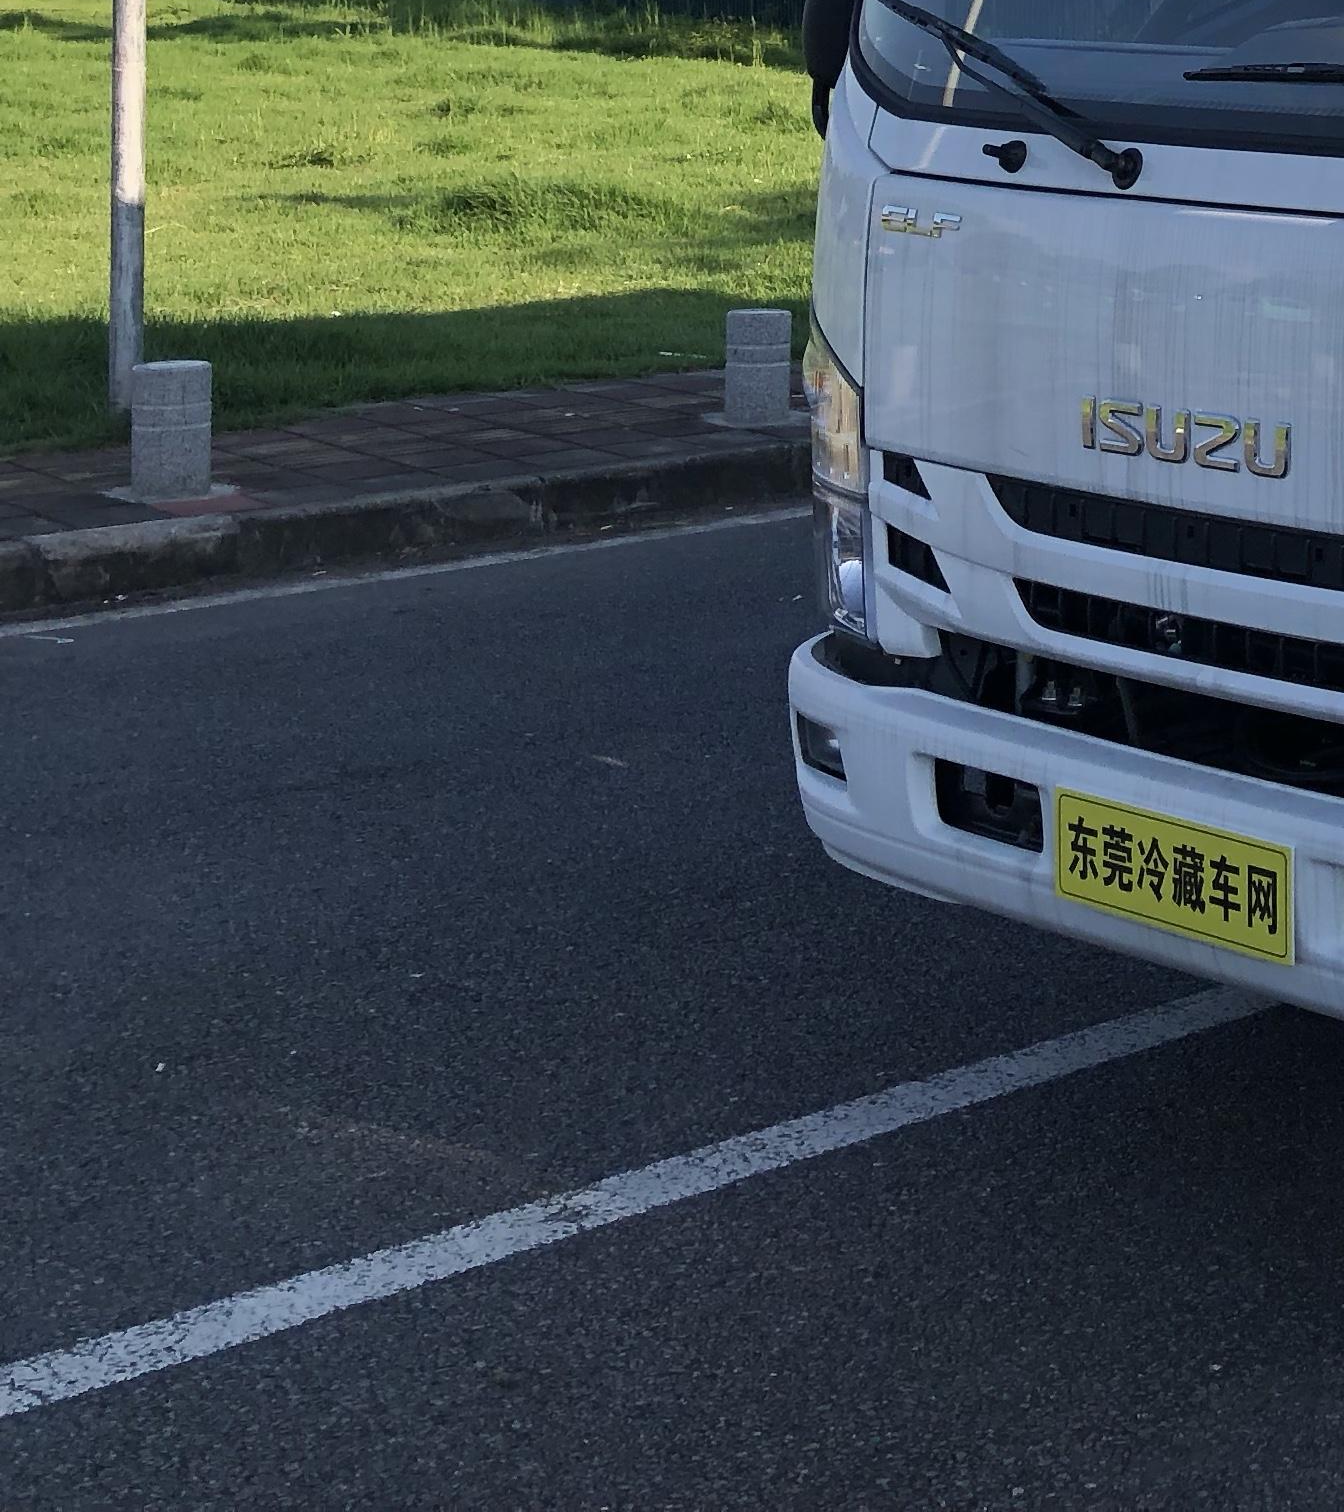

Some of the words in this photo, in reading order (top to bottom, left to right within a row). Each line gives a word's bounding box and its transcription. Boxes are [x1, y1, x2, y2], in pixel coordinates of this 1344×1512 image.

[881, 204, 962, 238] ELF
[1081, 395, 1292, 480] ISUZU
[1068, 816, 1278, 934] 东莞冷藏车网
